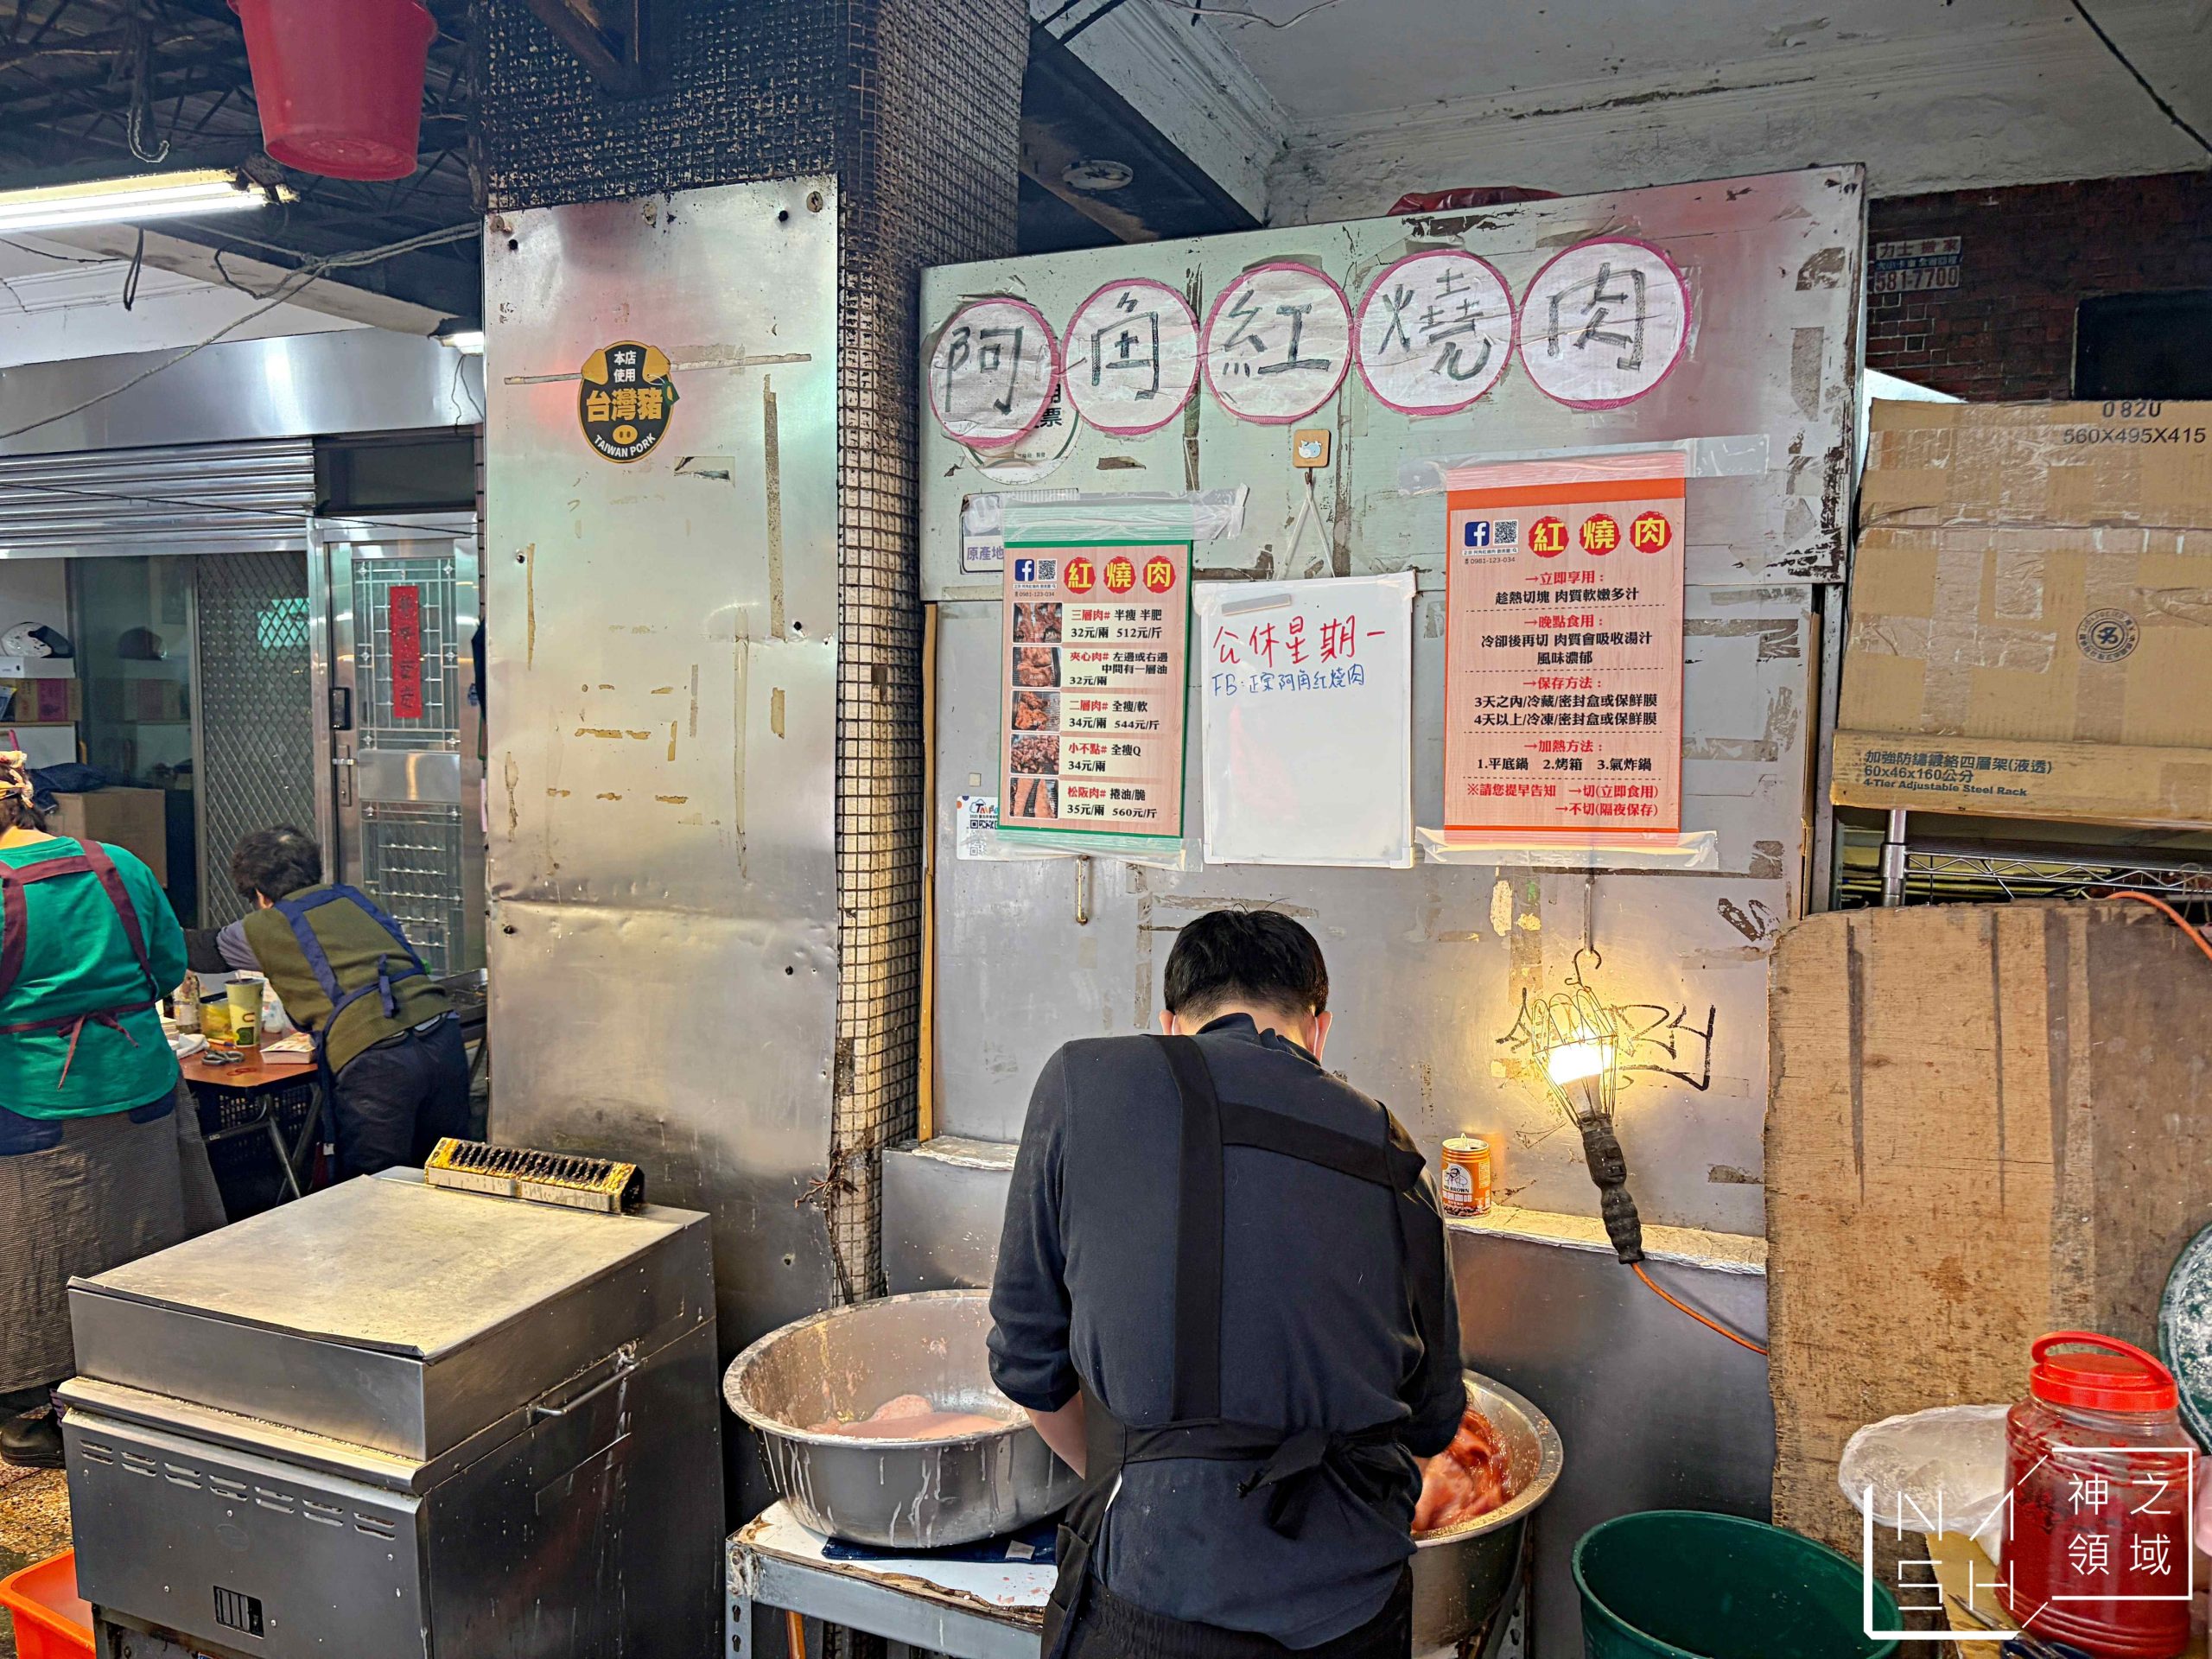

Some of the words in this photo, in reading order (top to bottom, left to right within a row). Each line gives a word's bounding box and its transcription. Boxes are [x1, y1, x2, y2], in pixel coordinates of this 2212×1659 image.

[1876, 267, 1958, 291] 581-7700
[614, 350, 637, 365] 本店
[613, 368, 636, 383] 使用
[587, 387, 663, 422] 台灣豬
[2063, 428, 2206, 443] 560X495X415
[594, 435, 628, 457] TAIWAN
[630, 433, 656, 456] PORK
[1533, 518, 1665, 552] 紅燒肉
[966, 545, 1004, 562] 原產地
[1068, 562, 1171, 588] 紅燒肉
[1555, 588, 1639, 603] 肉質軟嫩多汁
[1114, 609, 1136, 621] 半瘦
[1141, 609, 1162, 621] 半肥
[1071, 628, 1109, 639] 32元/兩
[1116, 627, 1162, 639] 512元/斤
[1481, 633, 1548, 648] 冷卻後再切
[1554, 632, 1652, 647] 肉質會吸收湯汁
[1212, 614, 1386, 668] 公休星期一
[1113, 652, 1168, 663] 左邊或右邊
[1537, 651, 1592, 665] 風味濃郁
[1102, 664, 1168, 675] 中間有一層油
[1070, 676, 1108, 686] 32元/兩
[1112, 701, 1148, 713] 全瘦/軟
[1069, 717, 1107, 728] 34元/兩
[1115, 720, 1160, 730] 544元/斤
[1111, 744, 1141, 757] 全瘦Q
[1068, 760, 1106, 772] 34元/兩
[1477, 758, 1529, 772] 1.平底鍋
[1542, 758, 1583, 772] 2.烤箱
[1597, 758, 1652, 772] 3.氣炸鍋
[1865, 766, 1974, 784] 60x46x160公分
[1864, 779, 1896, 788] 4-Tier
[1898, 780, 1960, 792] Adjustable
[1963, 785, 1993, 795] Steel
[1997, 786, 2027, 796] Rack
[1067, 804, 1105, 816] 35元/兩
[1112, 808, 1157, 818] 560元/斤
